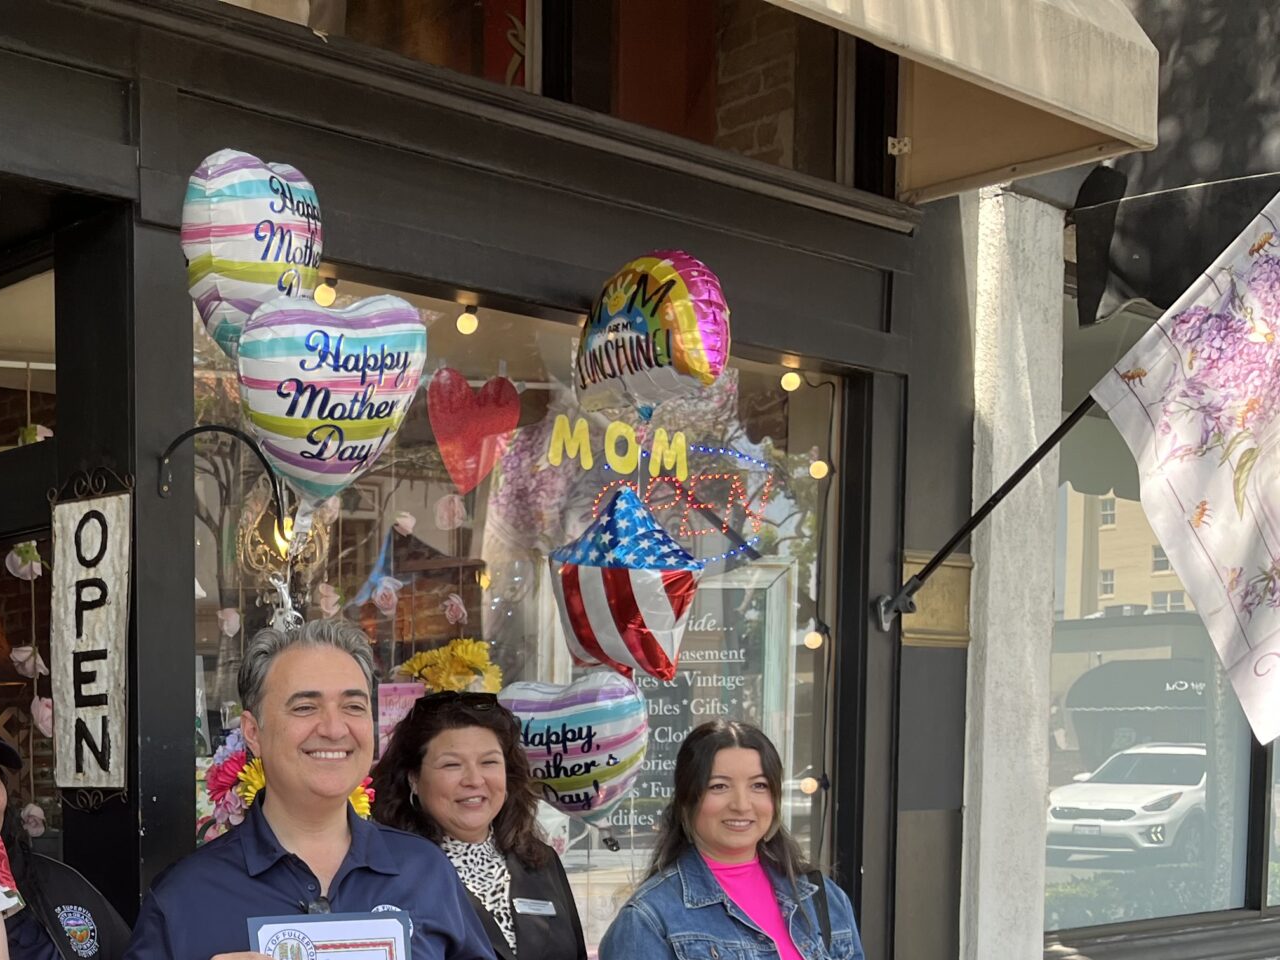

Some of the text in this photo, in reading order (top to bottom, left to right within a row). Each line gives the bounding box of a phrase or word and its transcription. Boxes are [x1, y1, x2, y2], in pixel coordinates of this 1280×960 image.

[268, 175, 321, 232] Happ
[254, 219, 321, 271] Mothe
[299, 329, 412, 388] Happy
[577, 328, 673, 390] SUNSHINE!
[300, 424, 390, 474] Day!
[548, 414, 688, 482] MOM
[73, 509, 111, 774] OPEN
[688, 613, 734, 632] ide...
[678, 648, 745, 661] asement
[683, 670, 745, 690] Vintage
[690, 698, 729, 715] Gifts
[531, 744, 620, 780] other's
[271, 935, 281, 946] OF
